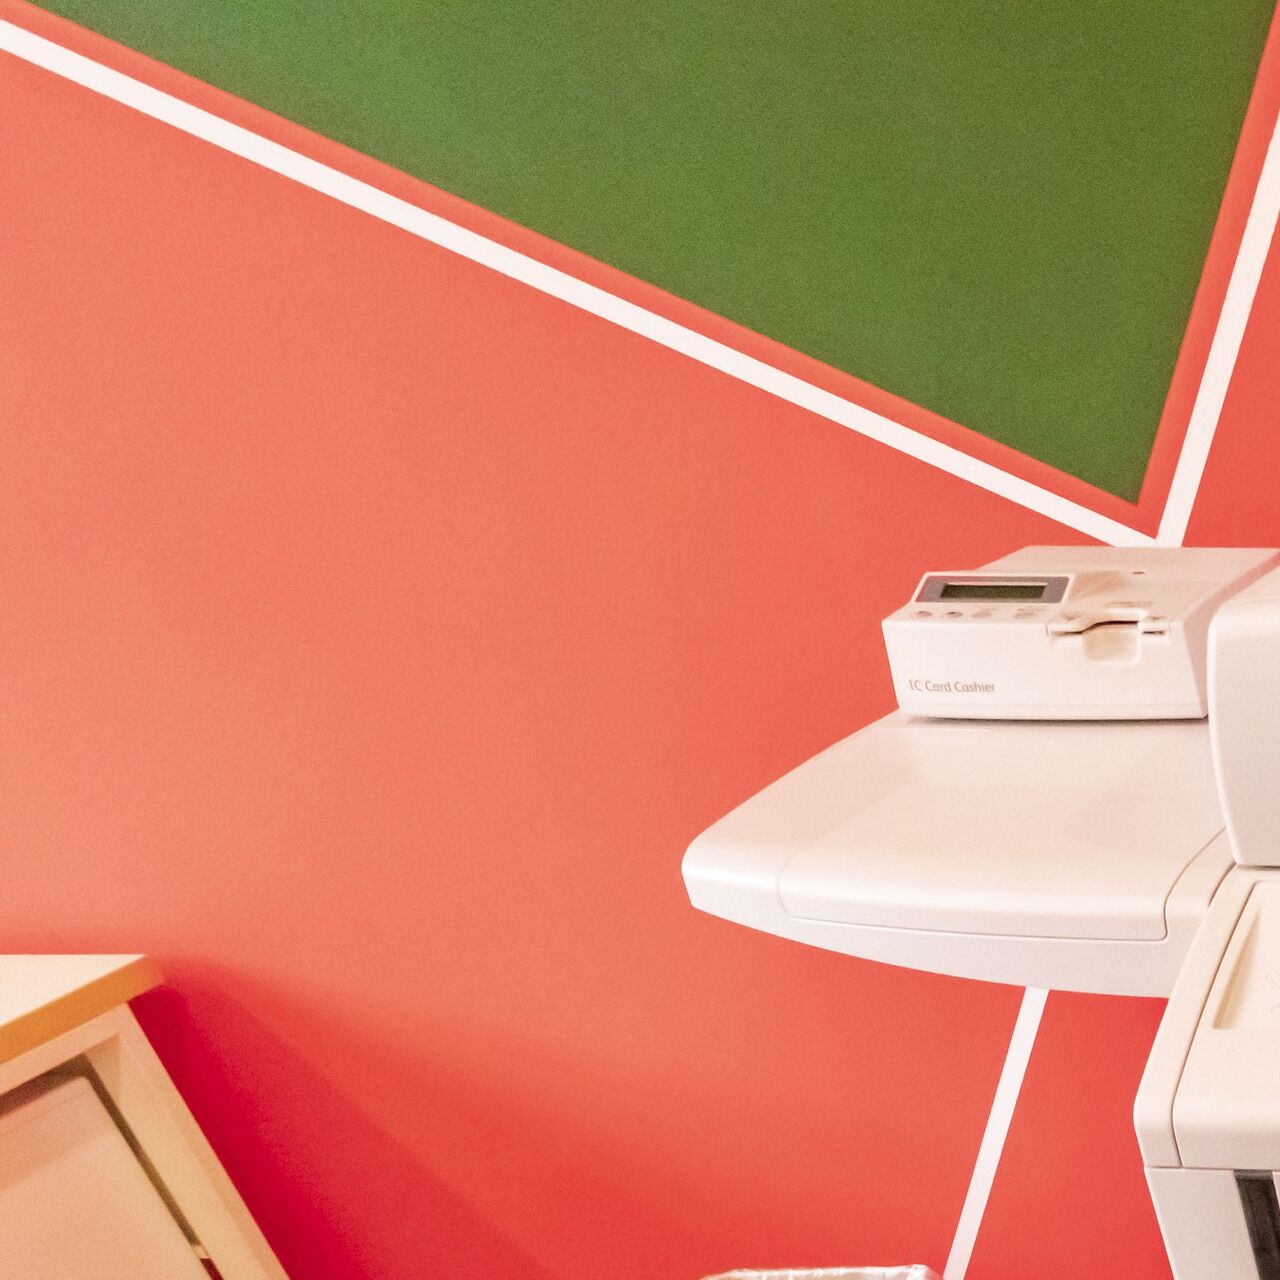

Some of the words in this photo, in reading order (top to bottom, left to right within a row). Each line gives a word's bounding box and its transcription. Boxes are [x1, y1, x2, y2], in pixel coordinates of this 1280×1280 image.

[909, 679, 922, 691] IC
[925, 680, 952, 692] Card
[954, 681, 995, 693] Cashier
